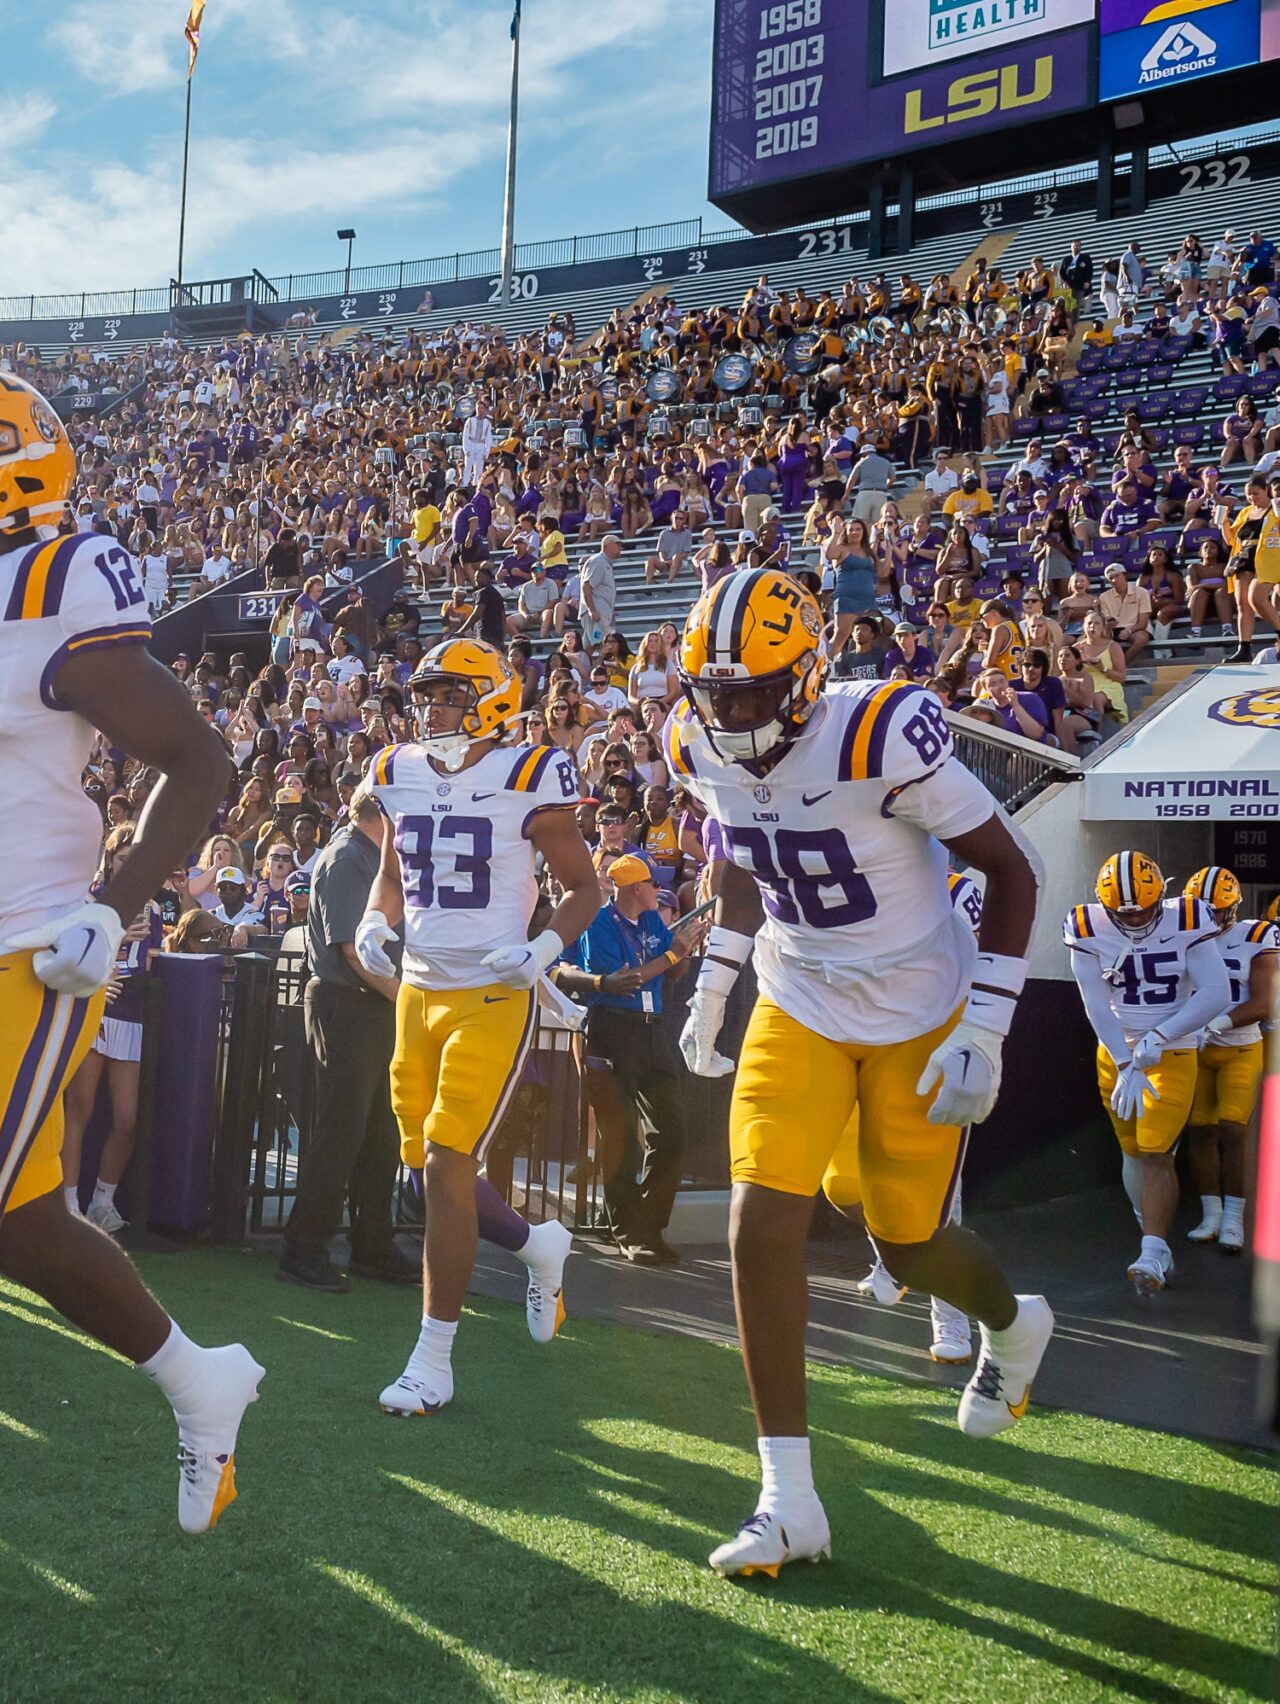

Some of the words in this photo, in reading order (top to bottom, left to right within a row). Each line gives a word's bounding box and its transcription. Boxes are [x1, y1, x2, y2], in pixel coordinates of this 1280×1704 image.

[759, 0, 822, 40] 1958
[936, 0, 1039, 39] HEALTH
[755, 34, 825, 82] 2003
[1138, 56, 1217, 84] Albertsons
[755, 75, 823, 120] 2007
[904, 55, 1054, 134] LSU
[755, 116, 819, 159] 2019
[1178, 156, 1252, 195] 232
[1034, 192, 1058, 205] 232
[980, 202, 1004, 215] 231
[798, 227, 853, 259] 231
[688, 250, 708, 262] 231
[643, 257, 663, 269] 230
[339, 298, 357, 308] 229
[378, 293, 397, 304] 230
[68, 322, 85, 331] 228
[104, 319, 121, 329] 229
[200, 385, 208, 395] 3
[73, 396, 92, 407] 229
[1102, 542, 1120, 551] LSU
[1148, 539, 1167, 547] LSU
[1085, 561, 1104, 570] LSU
[94, 547, 145, 612] 12
[979, 587, 998, 595] LSU
[246, 598, 276, 617] 231
[709, 667, 735, 677] LSU
[901, 696, 950, 767] 88
[1124, 779, 1280, 798] NATIONAL
[431, 803, 453, 812] LSU
[1155, 804, 1211, 817] 1958
[1229, 804, 1280, 817] 200
[752, 812, 780, 823] LSU
[1235, 830, 1267, 845] 1970
[1235, 853, 1267, 868] 1986
[1111, 951, 1180, 1005] 45
